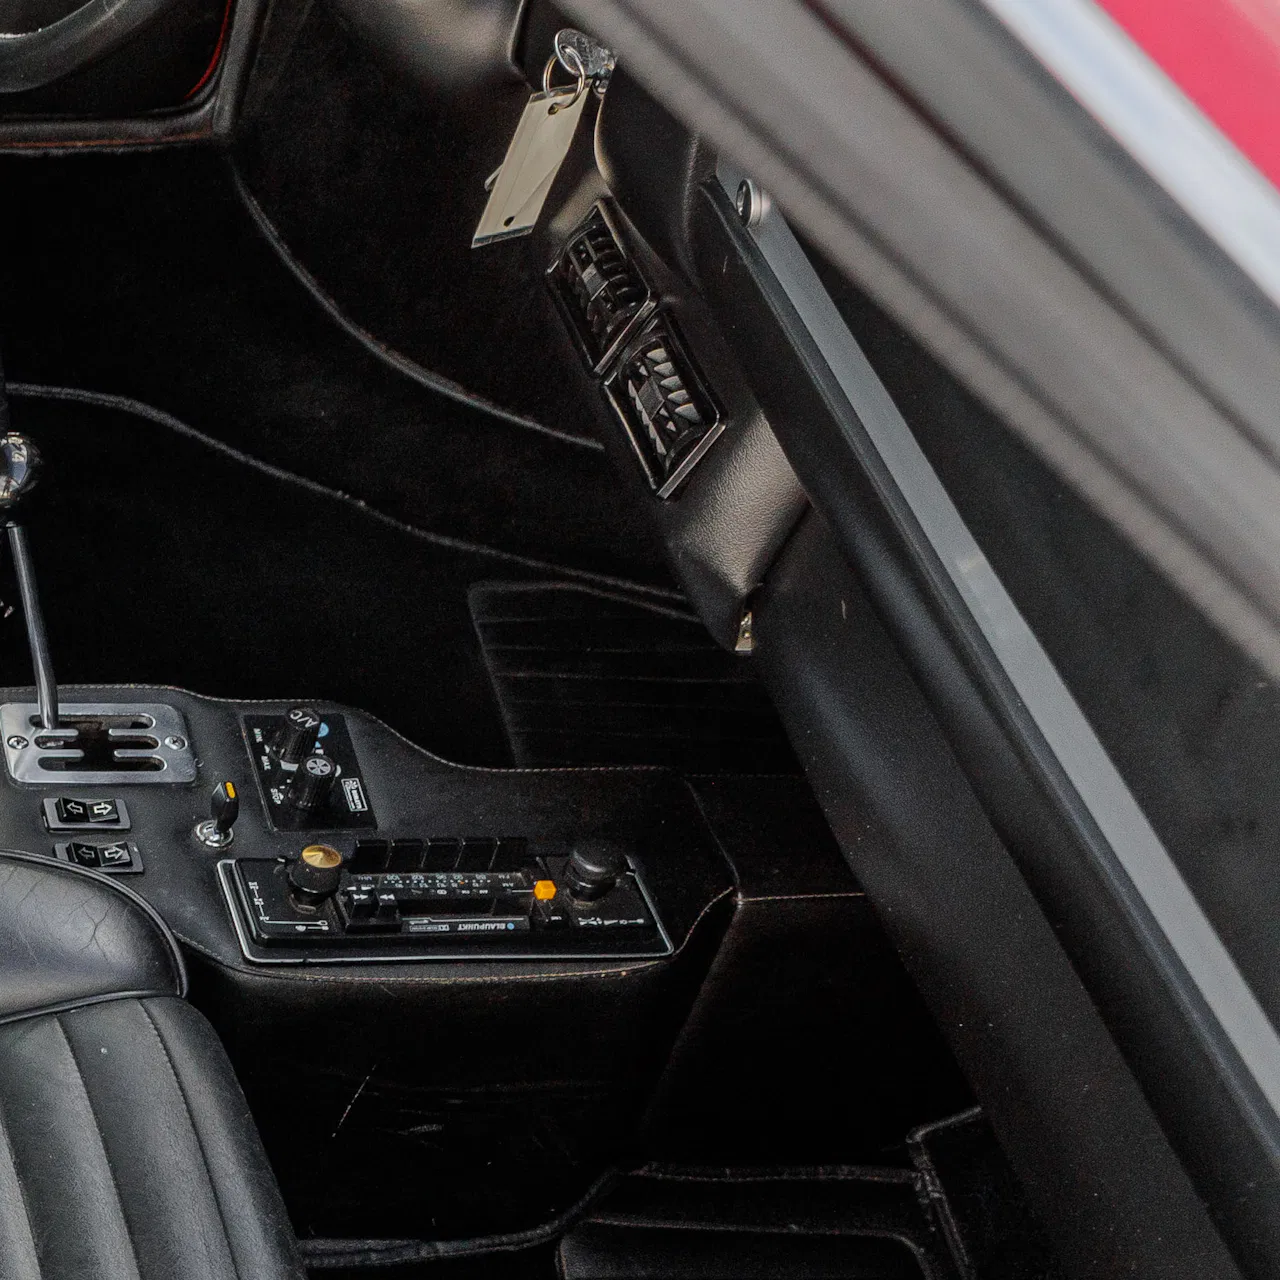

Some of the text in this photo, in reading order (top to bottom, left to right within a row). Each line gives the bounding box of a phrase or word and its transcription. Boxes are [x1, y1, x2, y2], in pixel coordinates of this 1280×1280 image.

[290, 710, 319, 728] A/C
[270, 788, 282, 805] STOP
[457, 922, 507, 931] BLAUPUNKT
